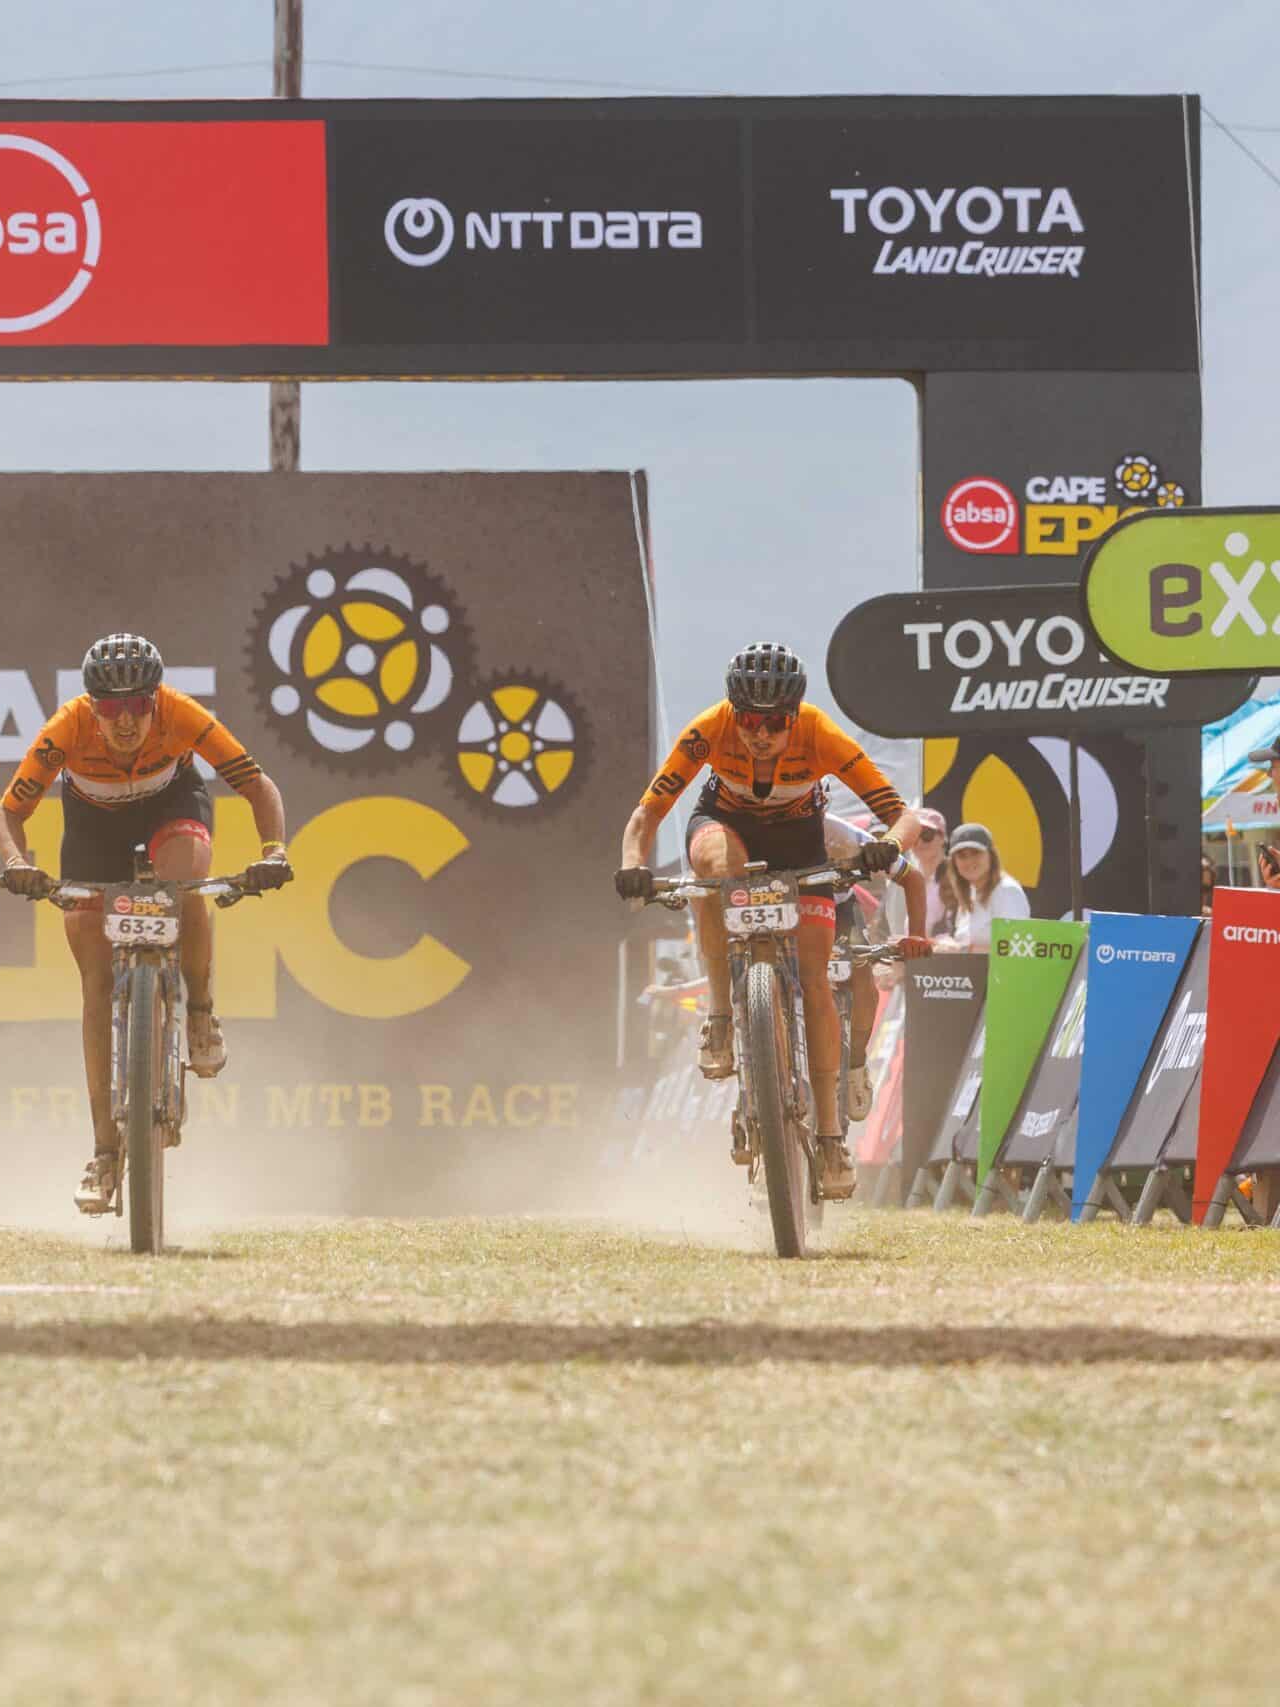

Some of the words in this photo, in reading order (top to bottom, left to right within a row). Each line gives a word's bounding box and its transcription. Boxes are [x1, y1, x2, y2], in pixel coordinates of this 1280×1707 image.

[830, 186, 1084, 234] TOYOTA
[466, 211, 563, 249] NTT
[1026, 476, 1106, 504] CAPE
[953, 500, 1007, 525] absa
[1149, 531, 1280, 637] ex
[904, 615, 1086, 670] TOYO
[118, 917, 167, 936] 63-2
[740, 907, 784, 924] 63-1
[997, 933, 1073, 961] exxaro
[1223, 925, 1280, 944] aram
[913, 975, 974, 989] TOYOTA
[264, 1085, 393, 1128] MTB
[417, 1084, 580, 1128] RACE
